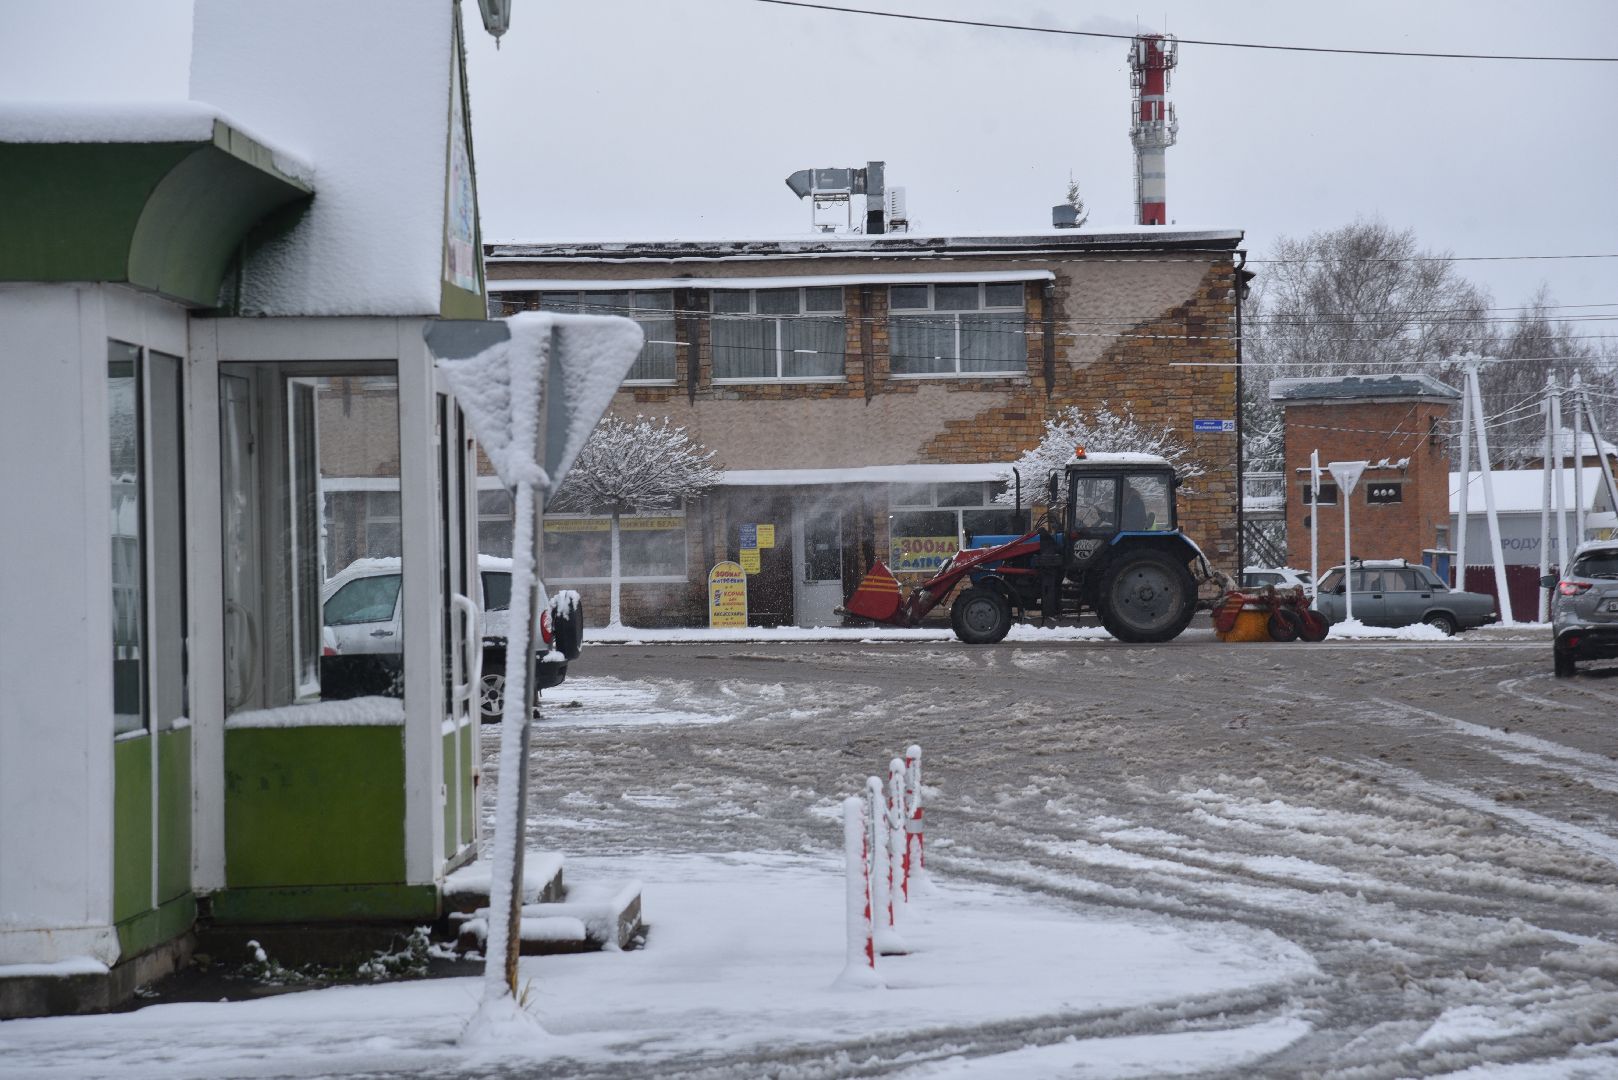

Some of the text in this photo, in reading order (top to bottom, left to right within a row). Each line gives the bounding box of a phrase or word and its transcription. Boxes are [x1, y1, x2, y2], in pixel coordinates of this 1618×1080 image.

[1223, 422, 1234, 430] 25
[901, 539, 958, 554] ЗООМА
[1501, 537, 1569, 551] РОДУТ
